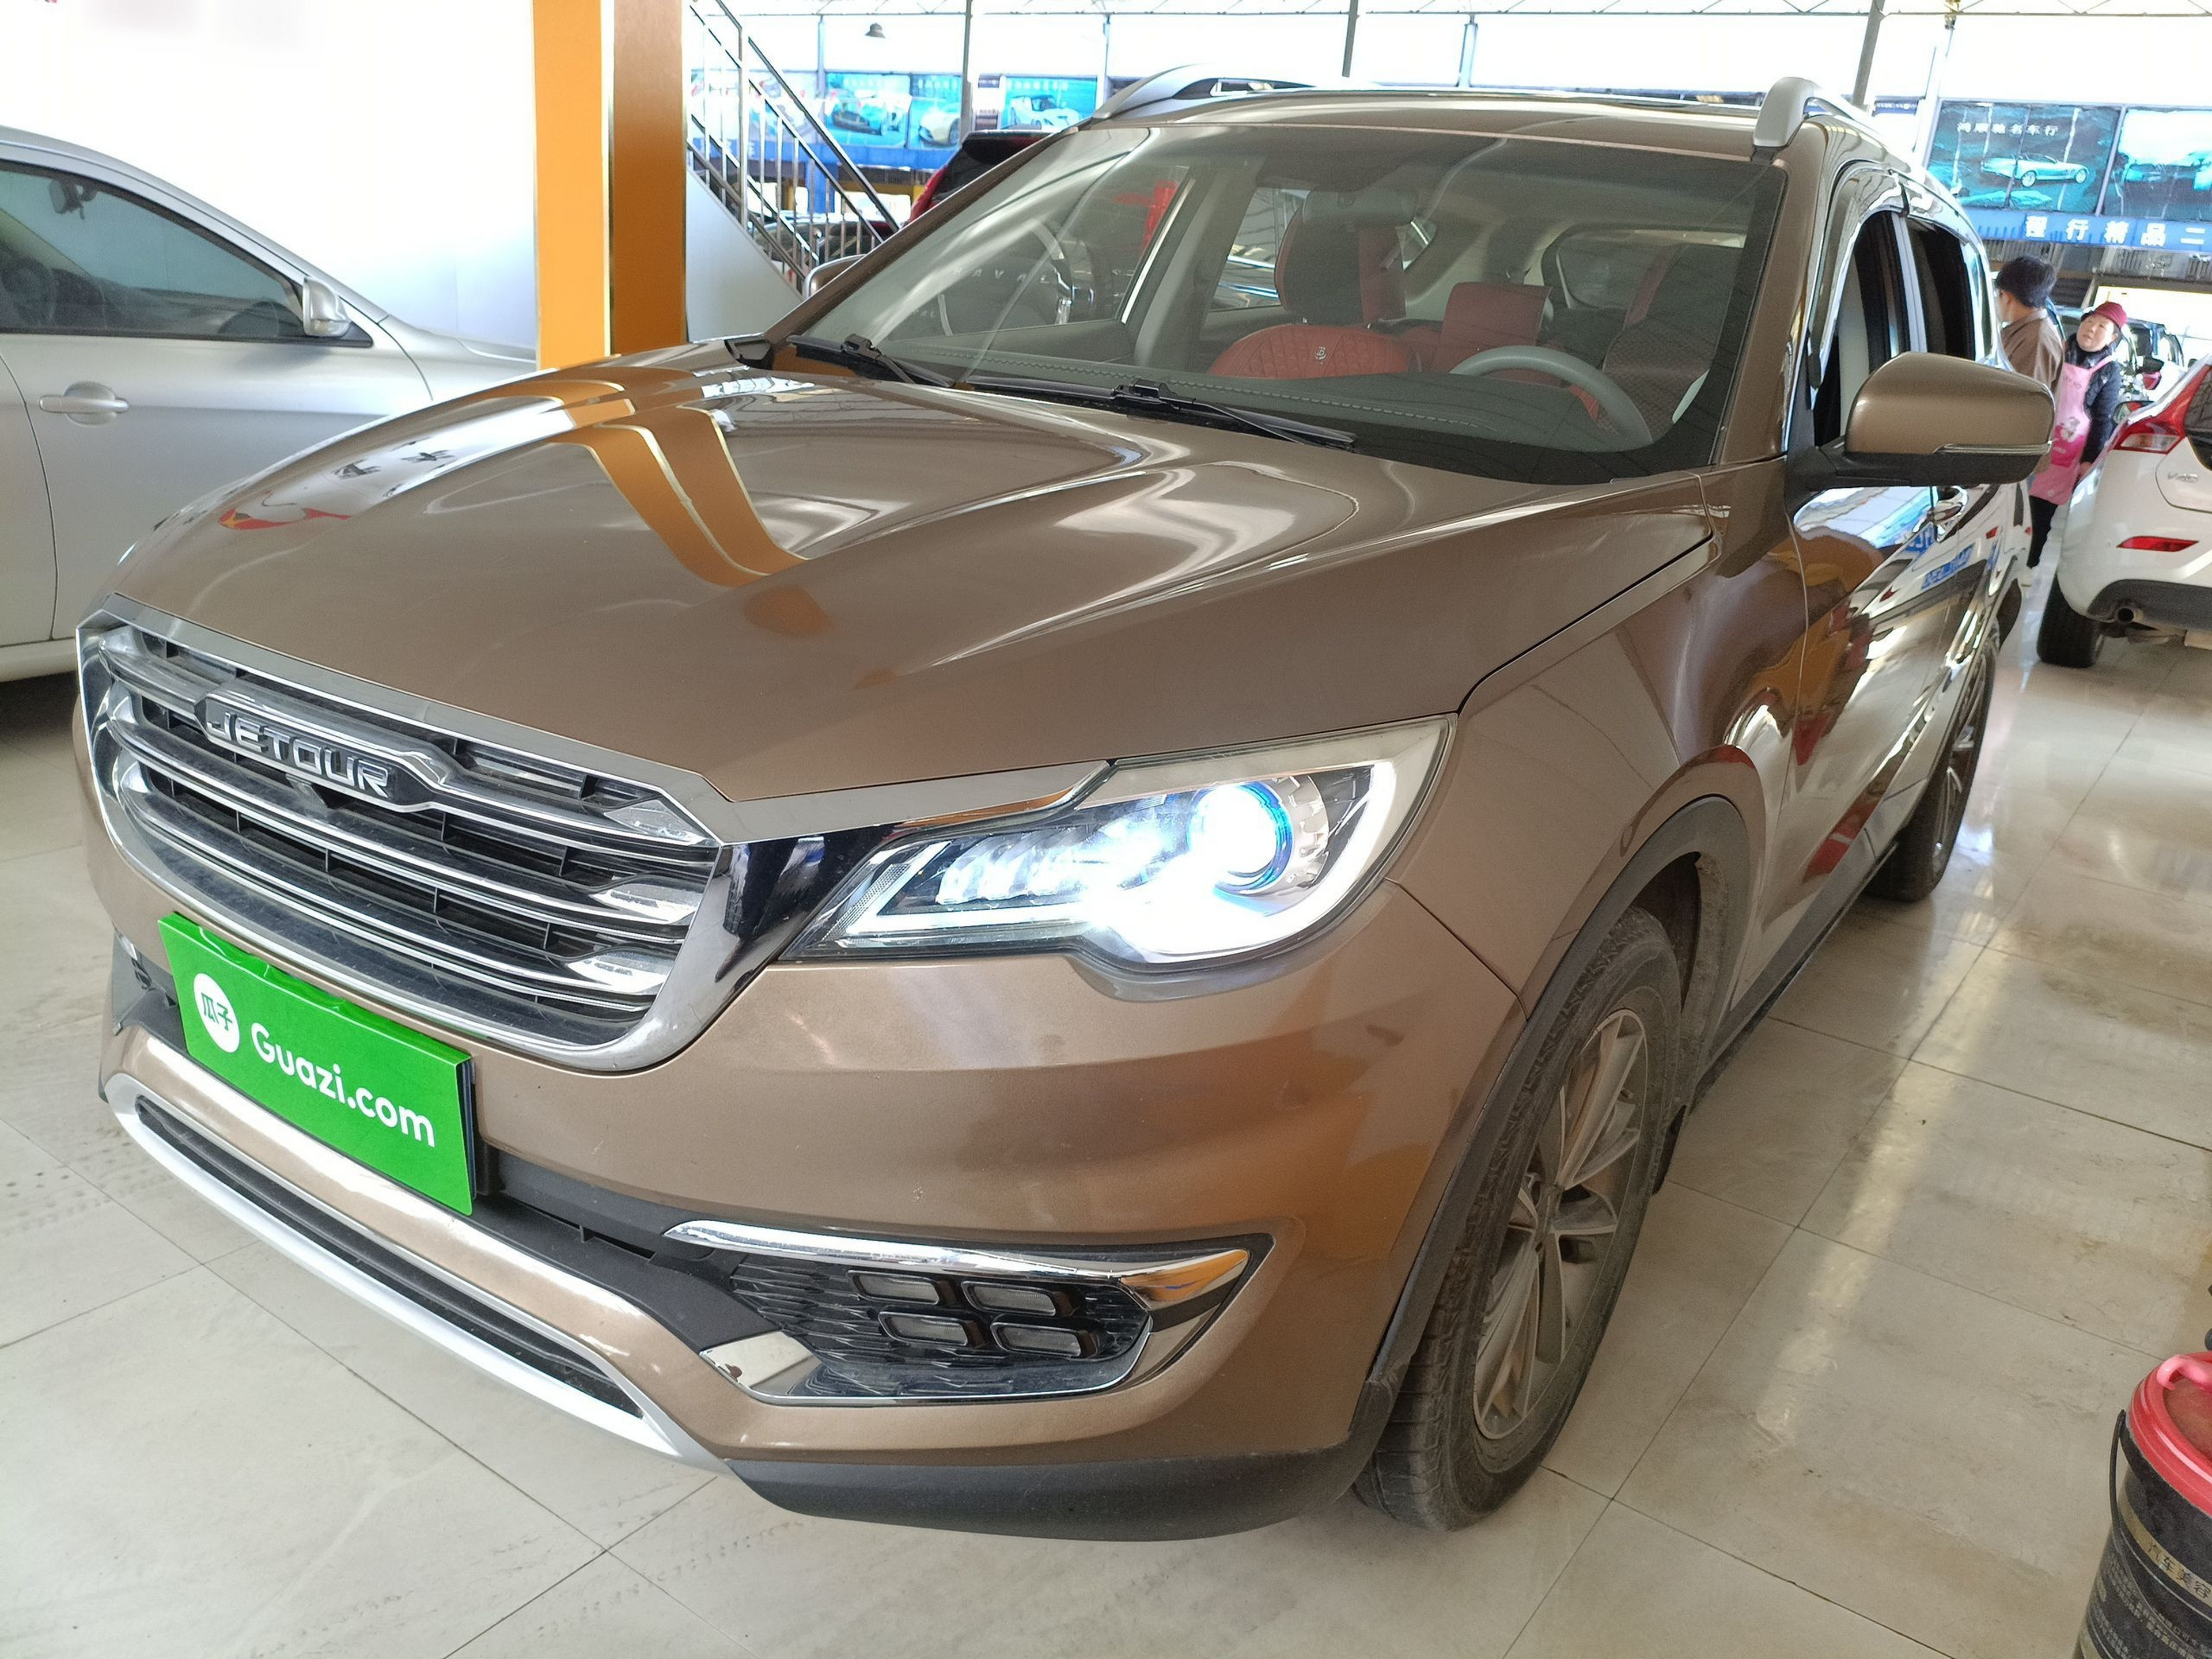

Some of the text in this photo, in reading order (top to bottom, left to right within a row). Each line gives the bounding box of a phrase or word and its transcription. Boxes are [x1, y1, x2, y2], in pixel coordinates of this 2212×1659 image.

[207, 712, 389, 798] JETOUR
[200, 993, 233, 1031] 瓜子
[251, 1022, 435, 1148] Guazi.com
[2147, 1541, 2211, 1599] 汽车美容
